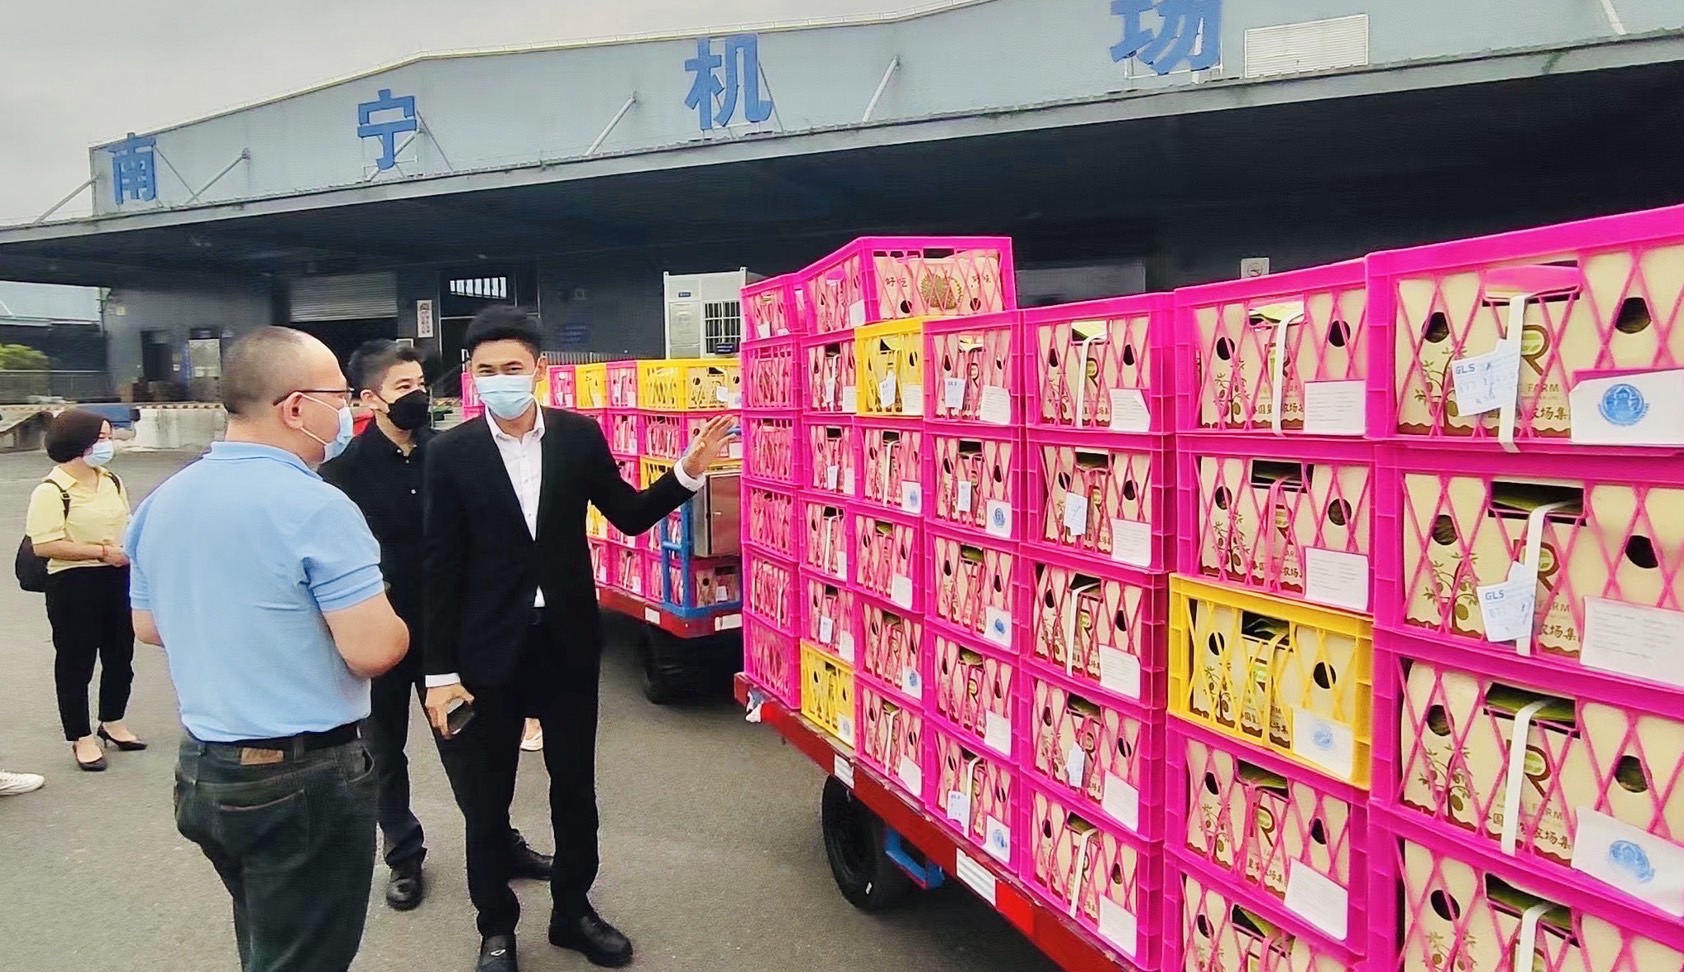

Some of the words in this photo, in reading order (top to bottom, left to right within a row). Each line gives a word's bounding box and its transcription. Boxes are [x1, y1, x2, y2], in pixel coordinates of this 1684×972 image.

[107, 132, 156, 205] 南
[358, 89, 417, 170] 宁
[685, 33, 772, 130] 机
[1110, 0, 1221, 75] 场
[1455, 363, 1476, 375] GLS
[1485, 589, 1505, 601] GLS
